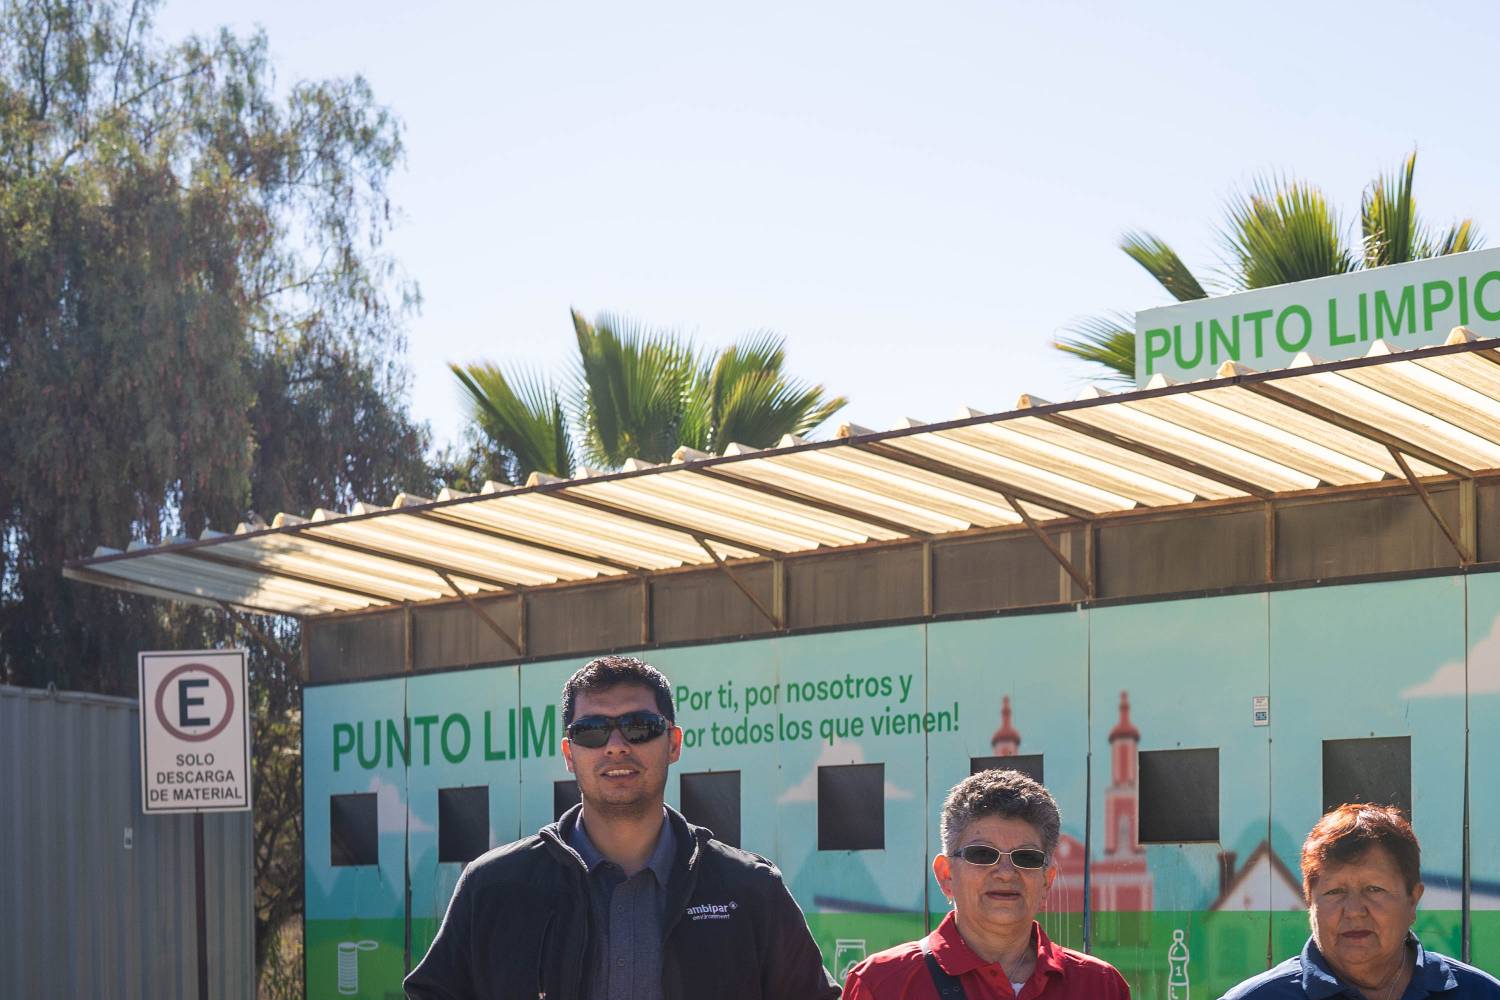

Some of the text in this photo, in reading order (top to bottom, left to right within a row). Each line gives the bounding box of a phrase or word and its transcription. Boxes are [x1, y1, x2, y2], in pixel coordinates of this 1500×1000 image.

[1145, 304, 1312, 375] PUNTO
[178, 679, 211, 727] E
[718, 680, 739, 713] ti,
[745, 682, 780, 714] por
[786, 673, 893, 703] nosotros
[899, 674, 913, 704] y
[333, 704, 557, 771] PUNTO LIM
[683, 701, 960, 748] or todos los que vienen!
[156, 770, 235, 785] DESCARGA
[176, 753, 214, 766] SOLO
[150, 787, 242, 802] DE MATERIAL
[687, 903, 728, 914] ambipar
